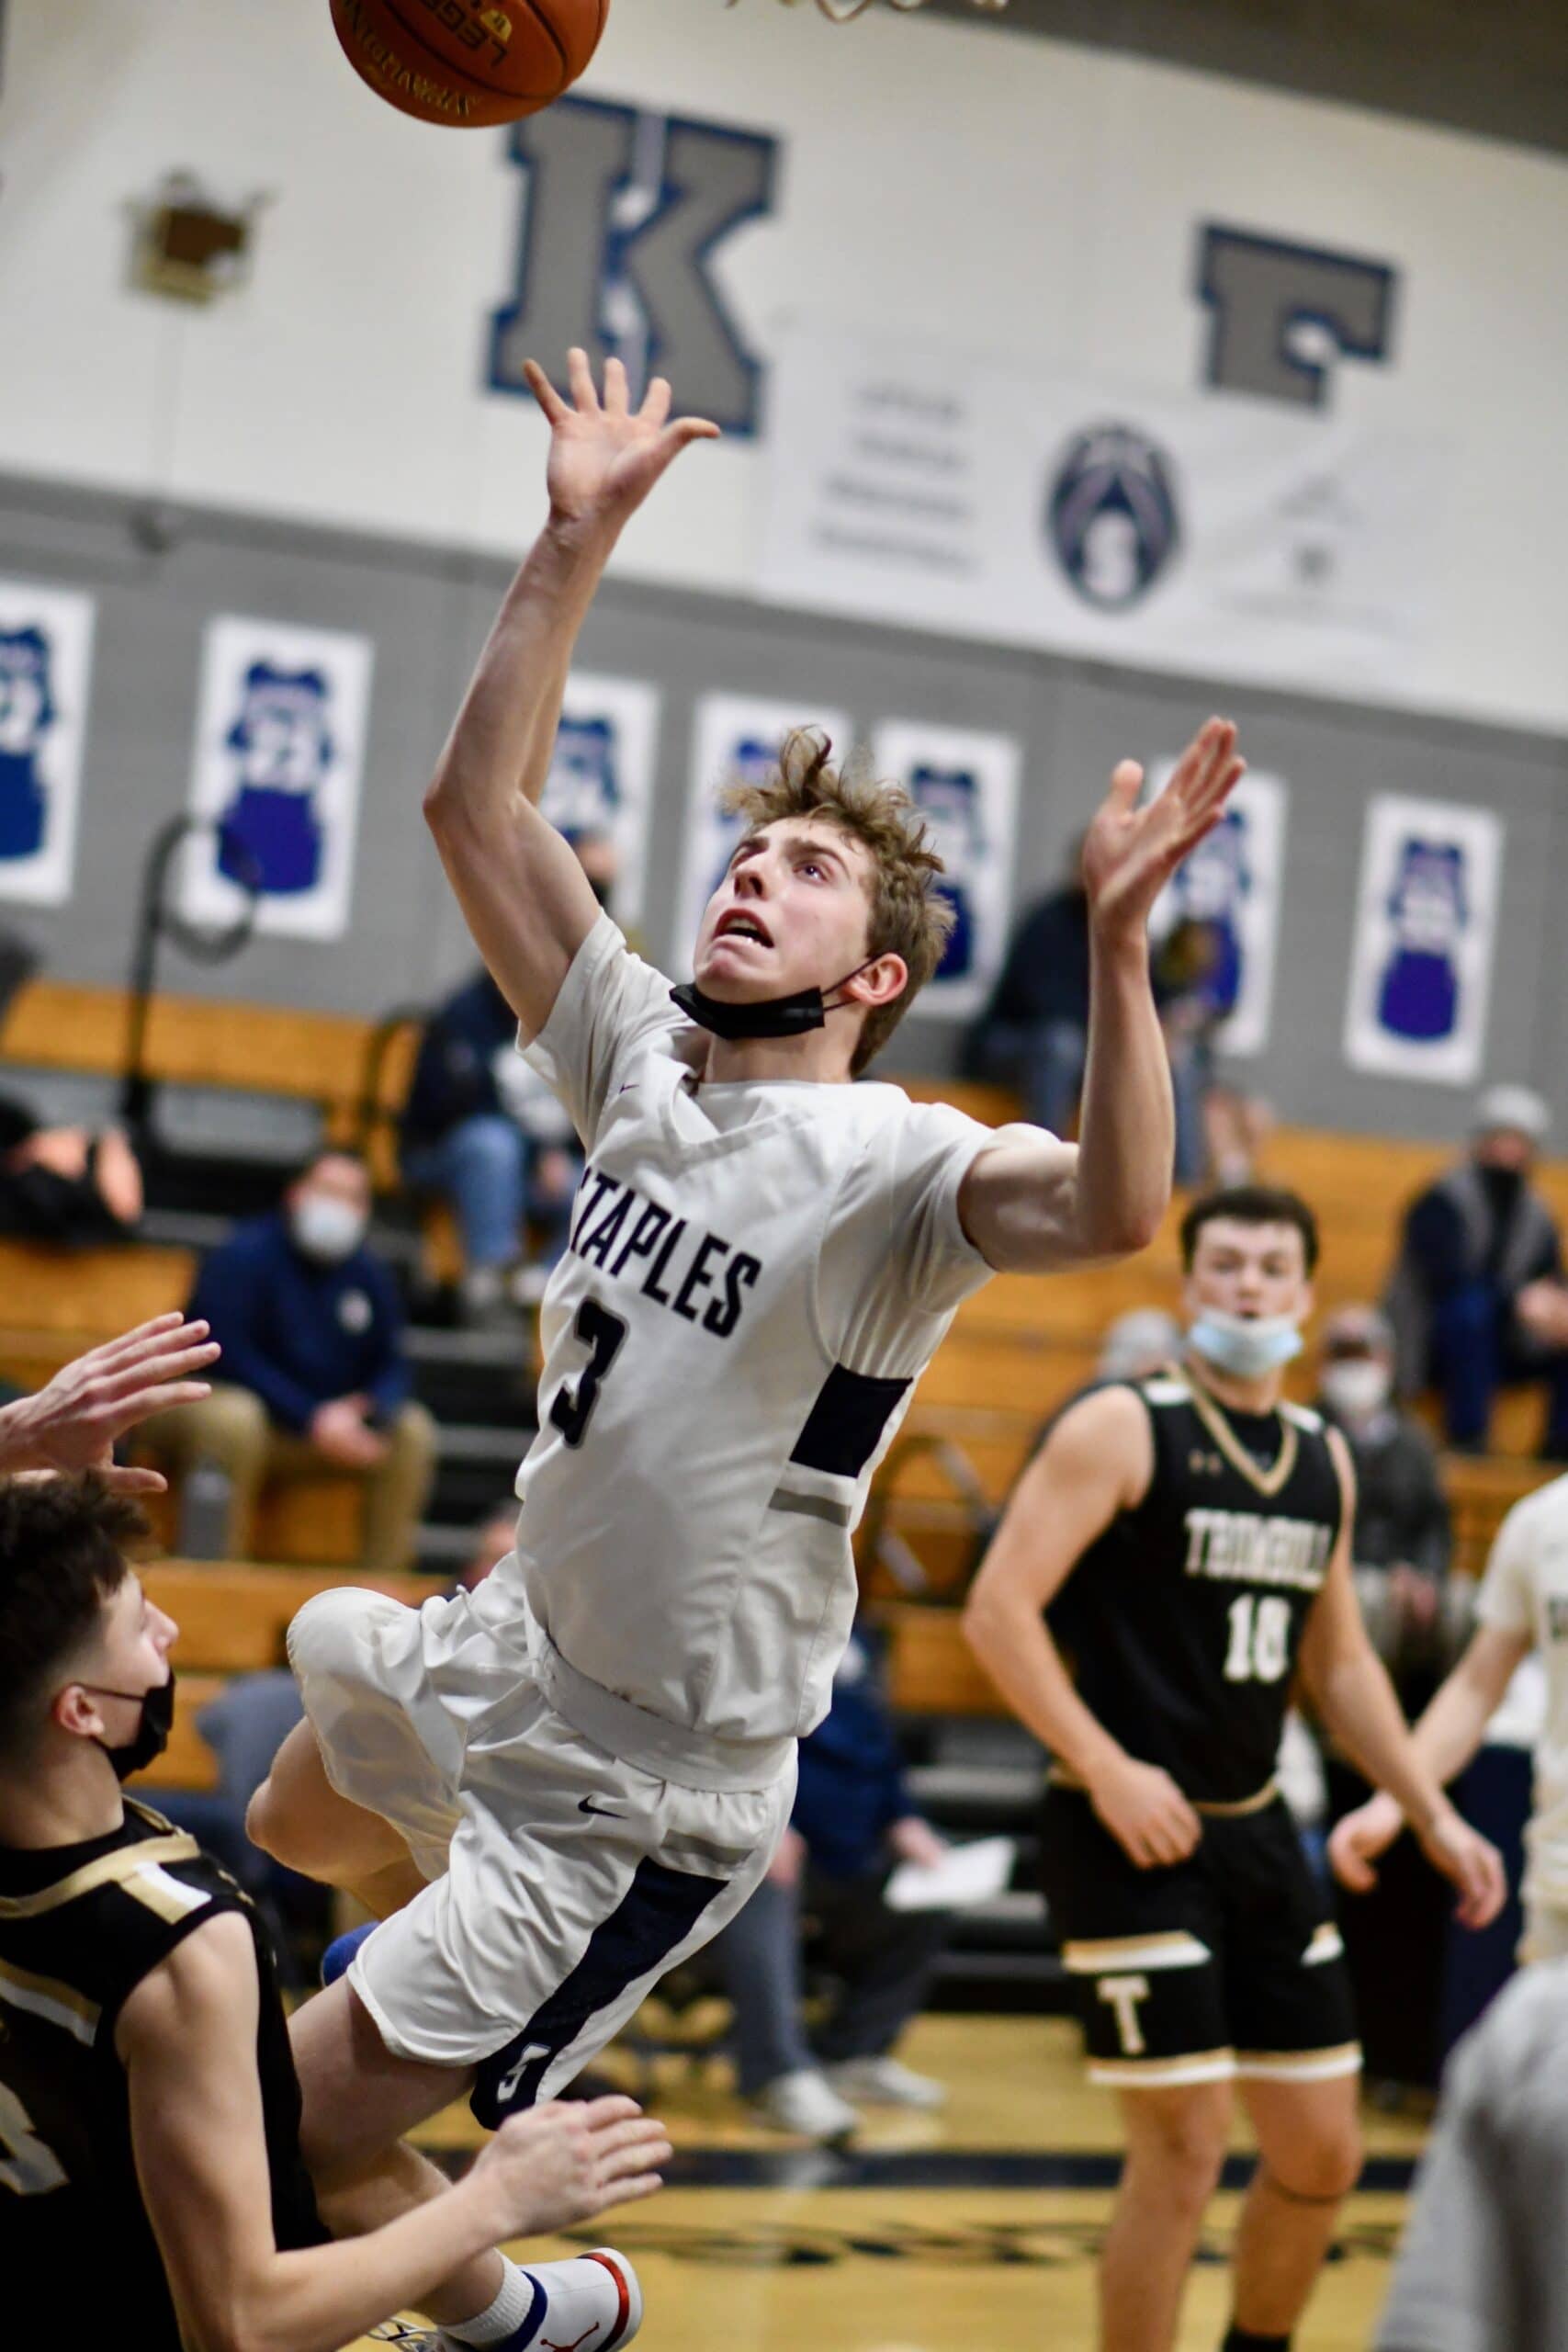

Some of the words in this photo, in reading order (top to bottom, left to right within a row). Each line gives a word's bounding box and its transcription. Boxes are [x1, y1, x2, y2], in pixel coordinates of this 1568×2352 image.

[482, 92, 783, 439] K
[548, 1295, 630, 1450] 3
[1224, 1591, 1293, 1683] 10
[1096, 1974, 1152, 2056] T
